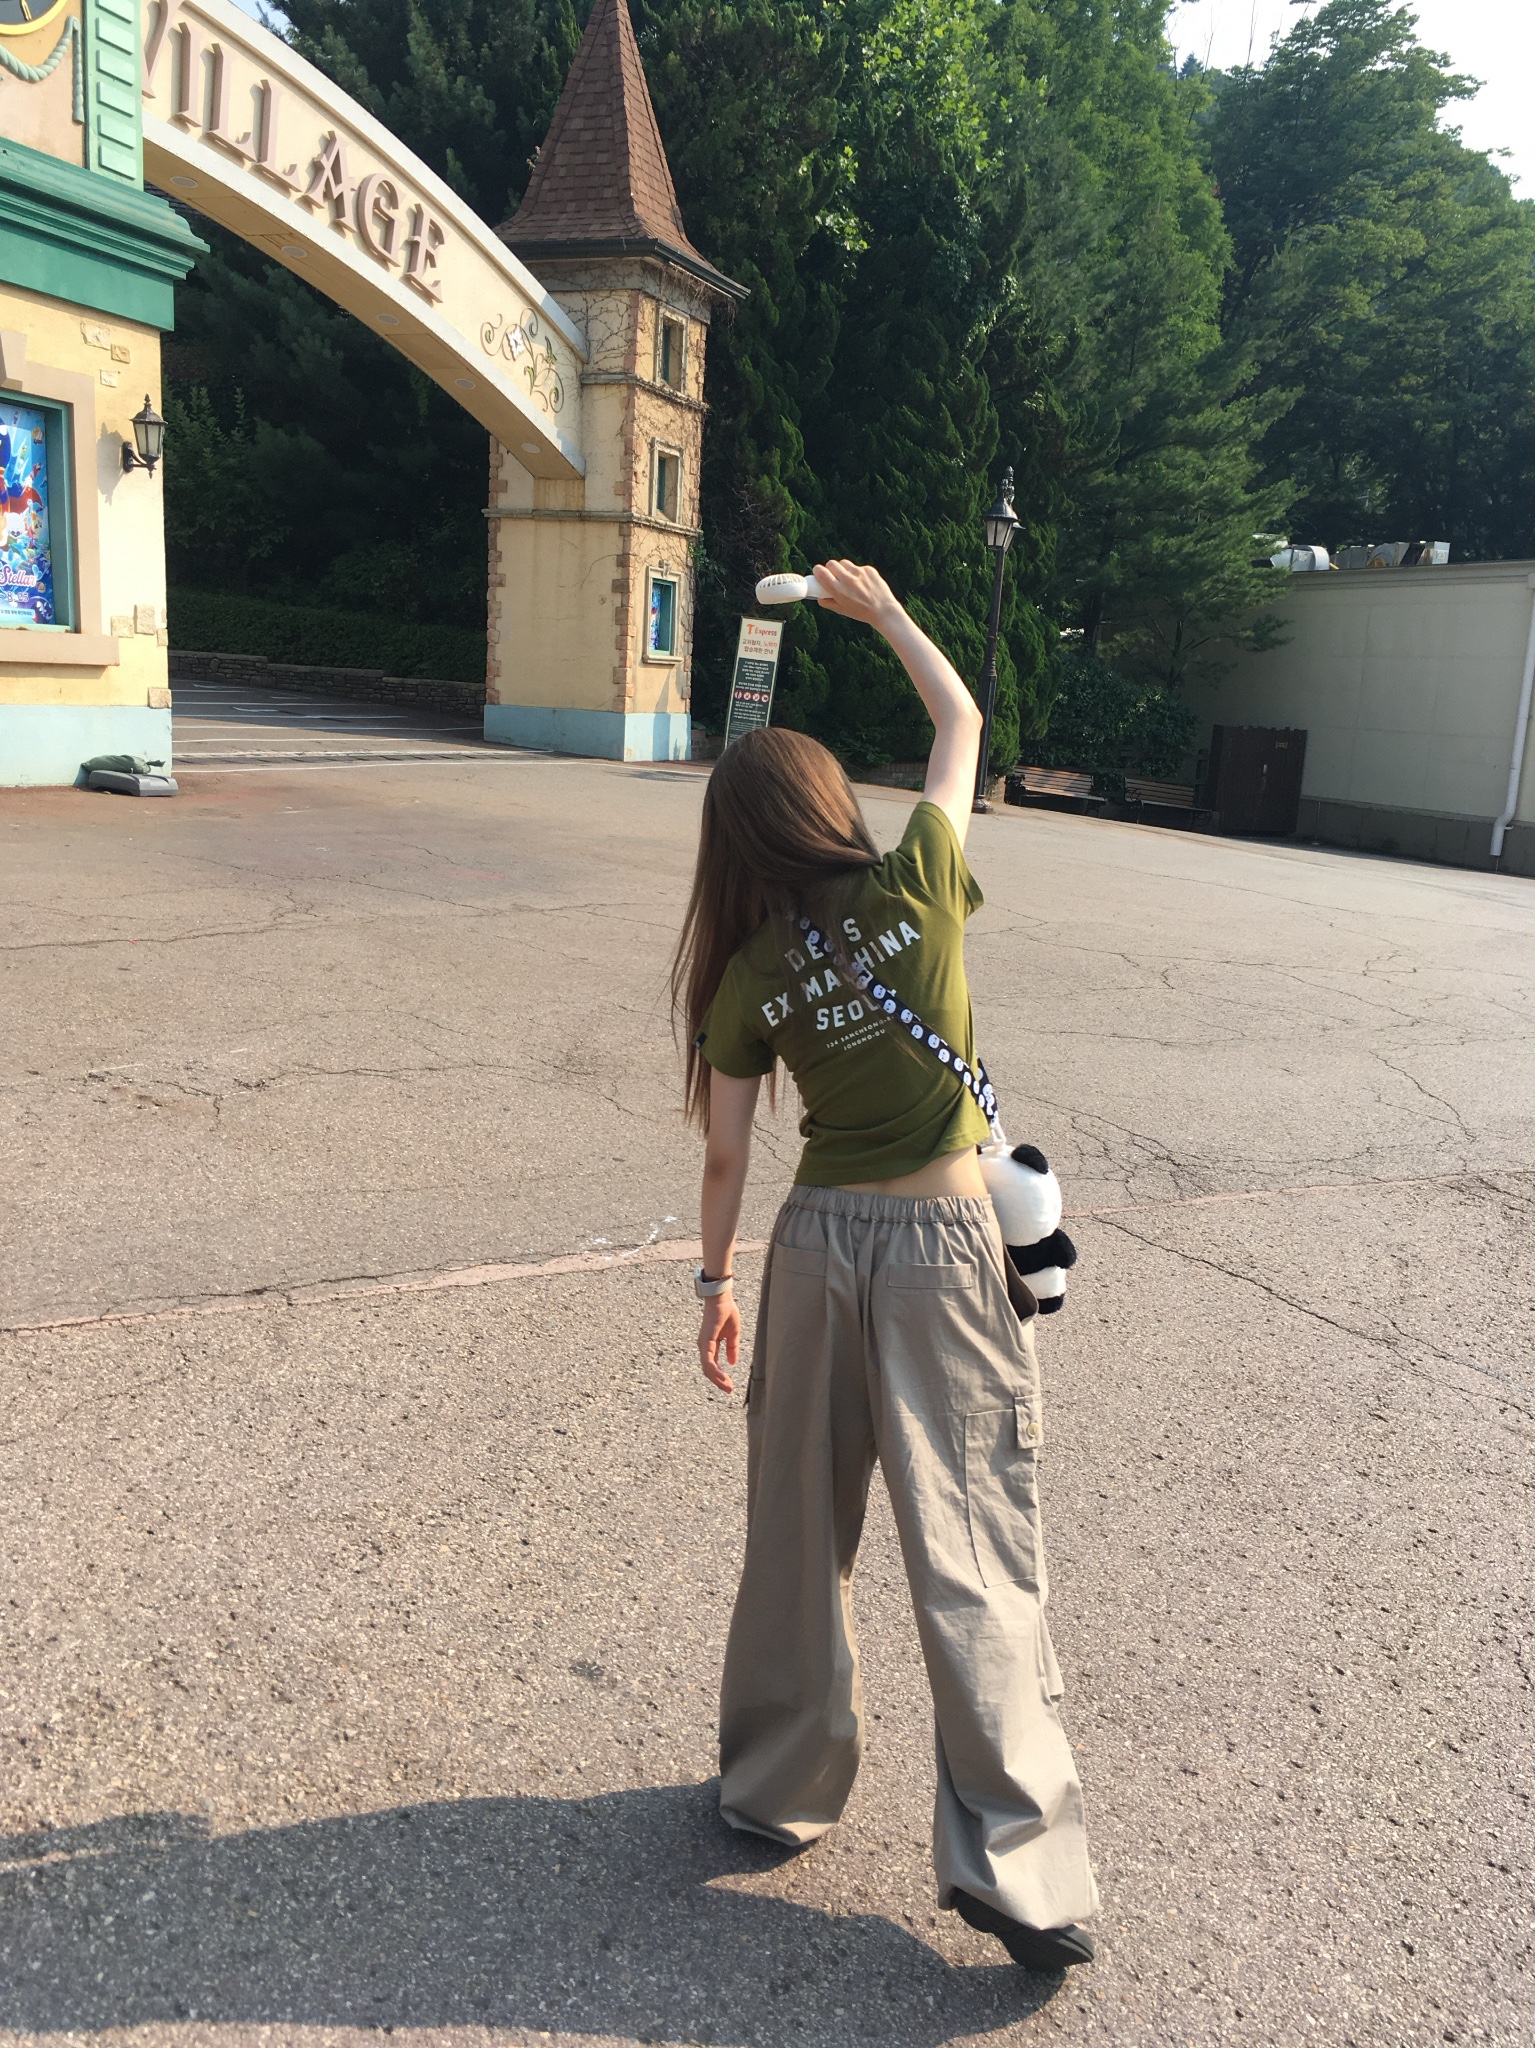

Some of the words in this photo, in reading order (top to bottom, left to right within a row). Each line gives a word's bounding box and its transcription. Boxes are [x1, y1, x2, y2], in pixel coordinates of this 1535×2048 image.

[747, 624, 755, 635] T
[755, 627, 777, 636] Express
[784, 918, 862, 972] DES
[761, 992, 793, 1027] EX
[800, 920, 921, 1002] MAHINA
